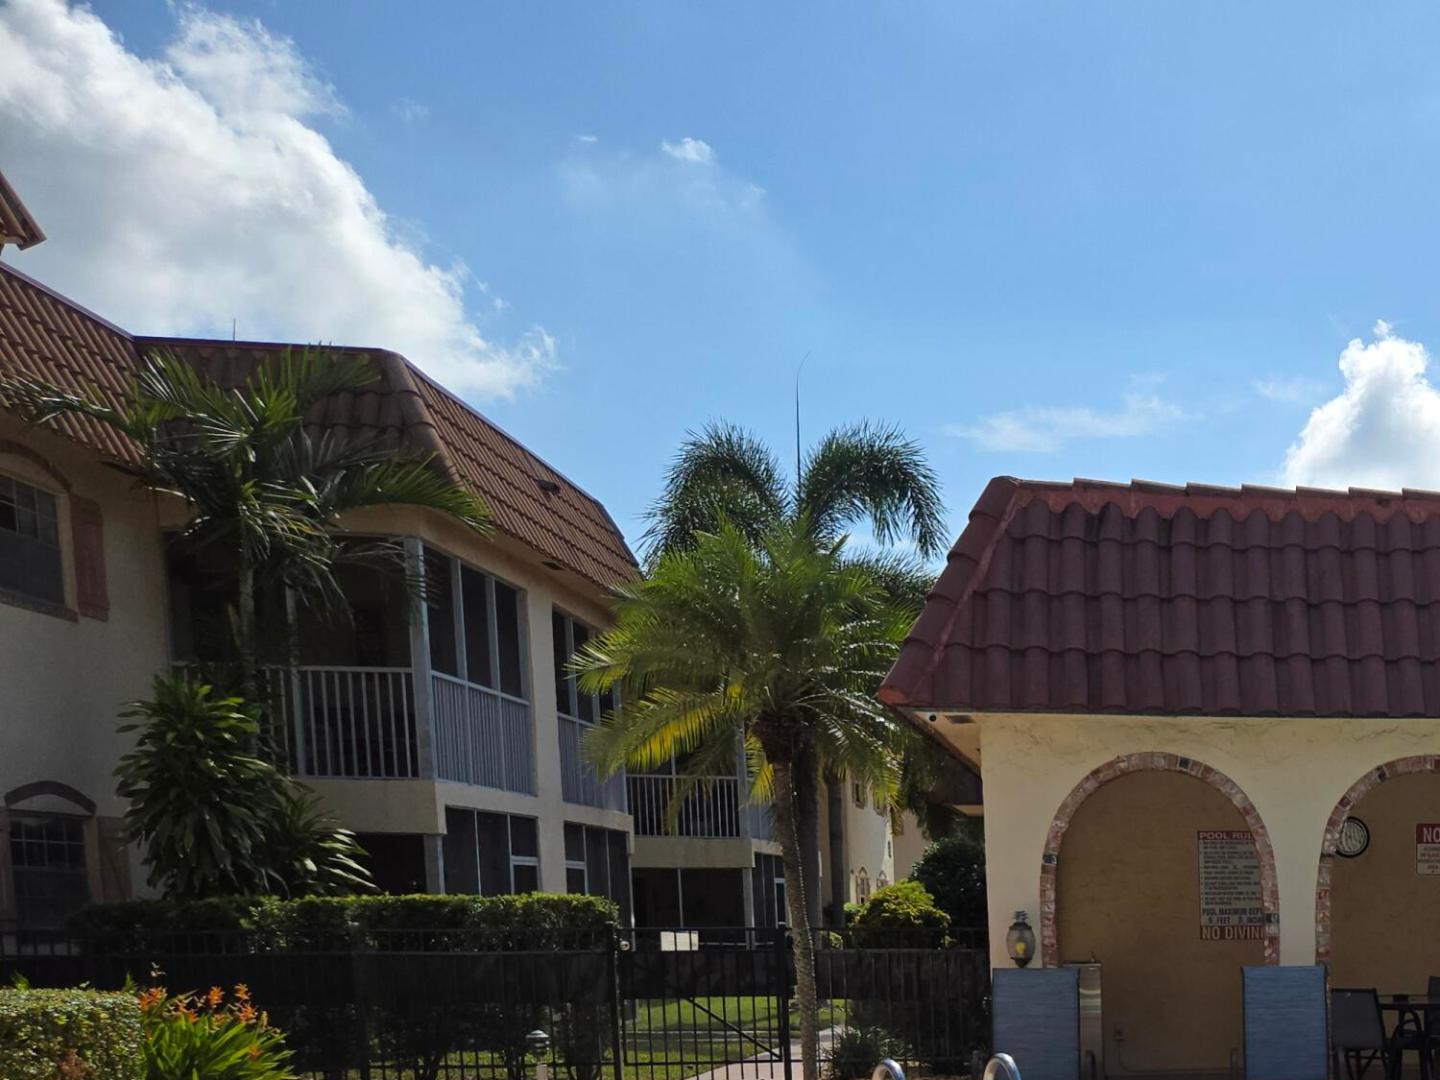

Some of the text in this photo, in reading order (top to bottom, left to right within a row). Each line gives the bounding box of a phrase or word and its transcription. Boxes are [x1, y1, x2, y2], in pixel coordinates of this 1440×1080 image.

[1232, 832, 1252, 840] RUL
[1202, 926, 1265, 940] NO DIVIN
